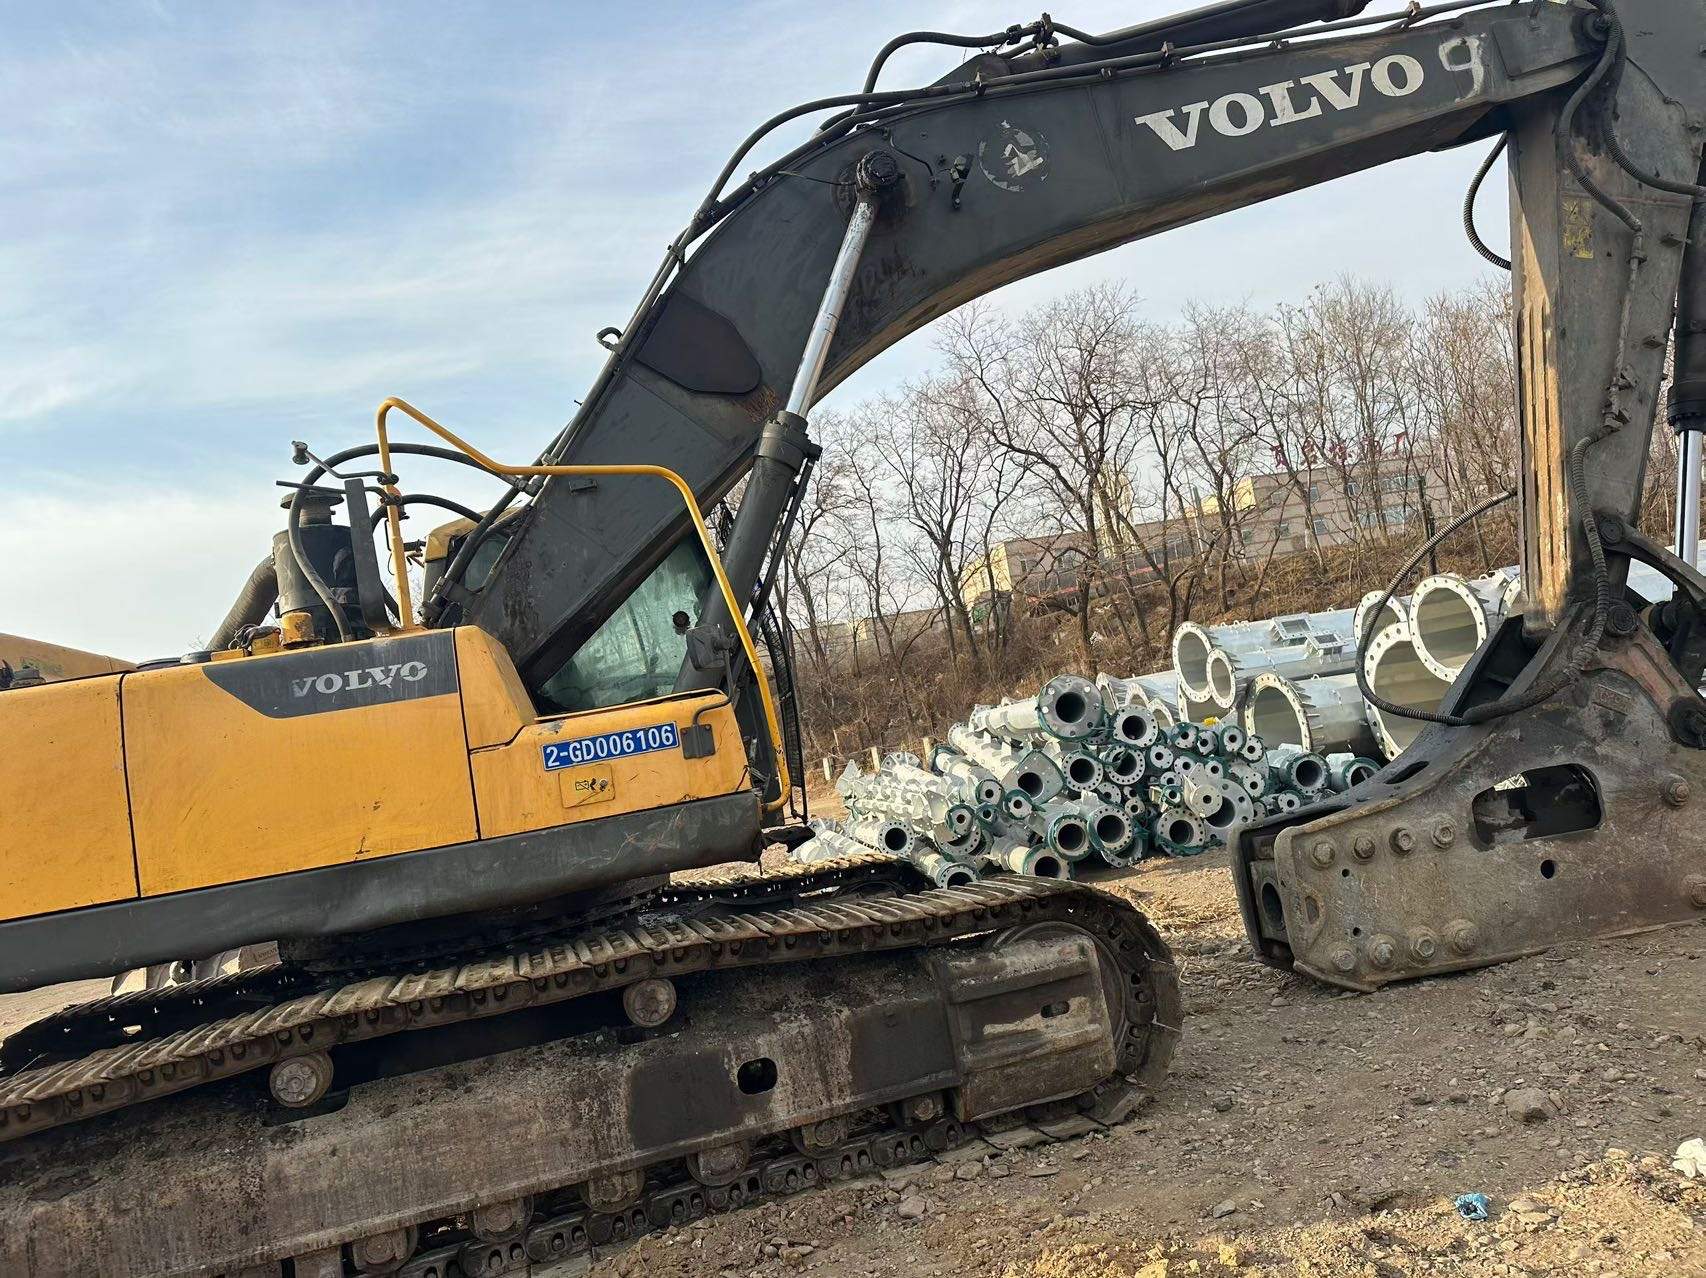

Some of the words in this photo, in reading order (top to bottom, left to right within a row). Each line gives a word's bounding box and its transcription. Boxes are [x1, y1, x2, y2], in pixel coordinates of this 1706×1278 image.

[1134, 54, 1425, 152] VOLVO
[291, 661, 428, 697] VOLVO
[546, 725, 673, 767] 2-GD006106
